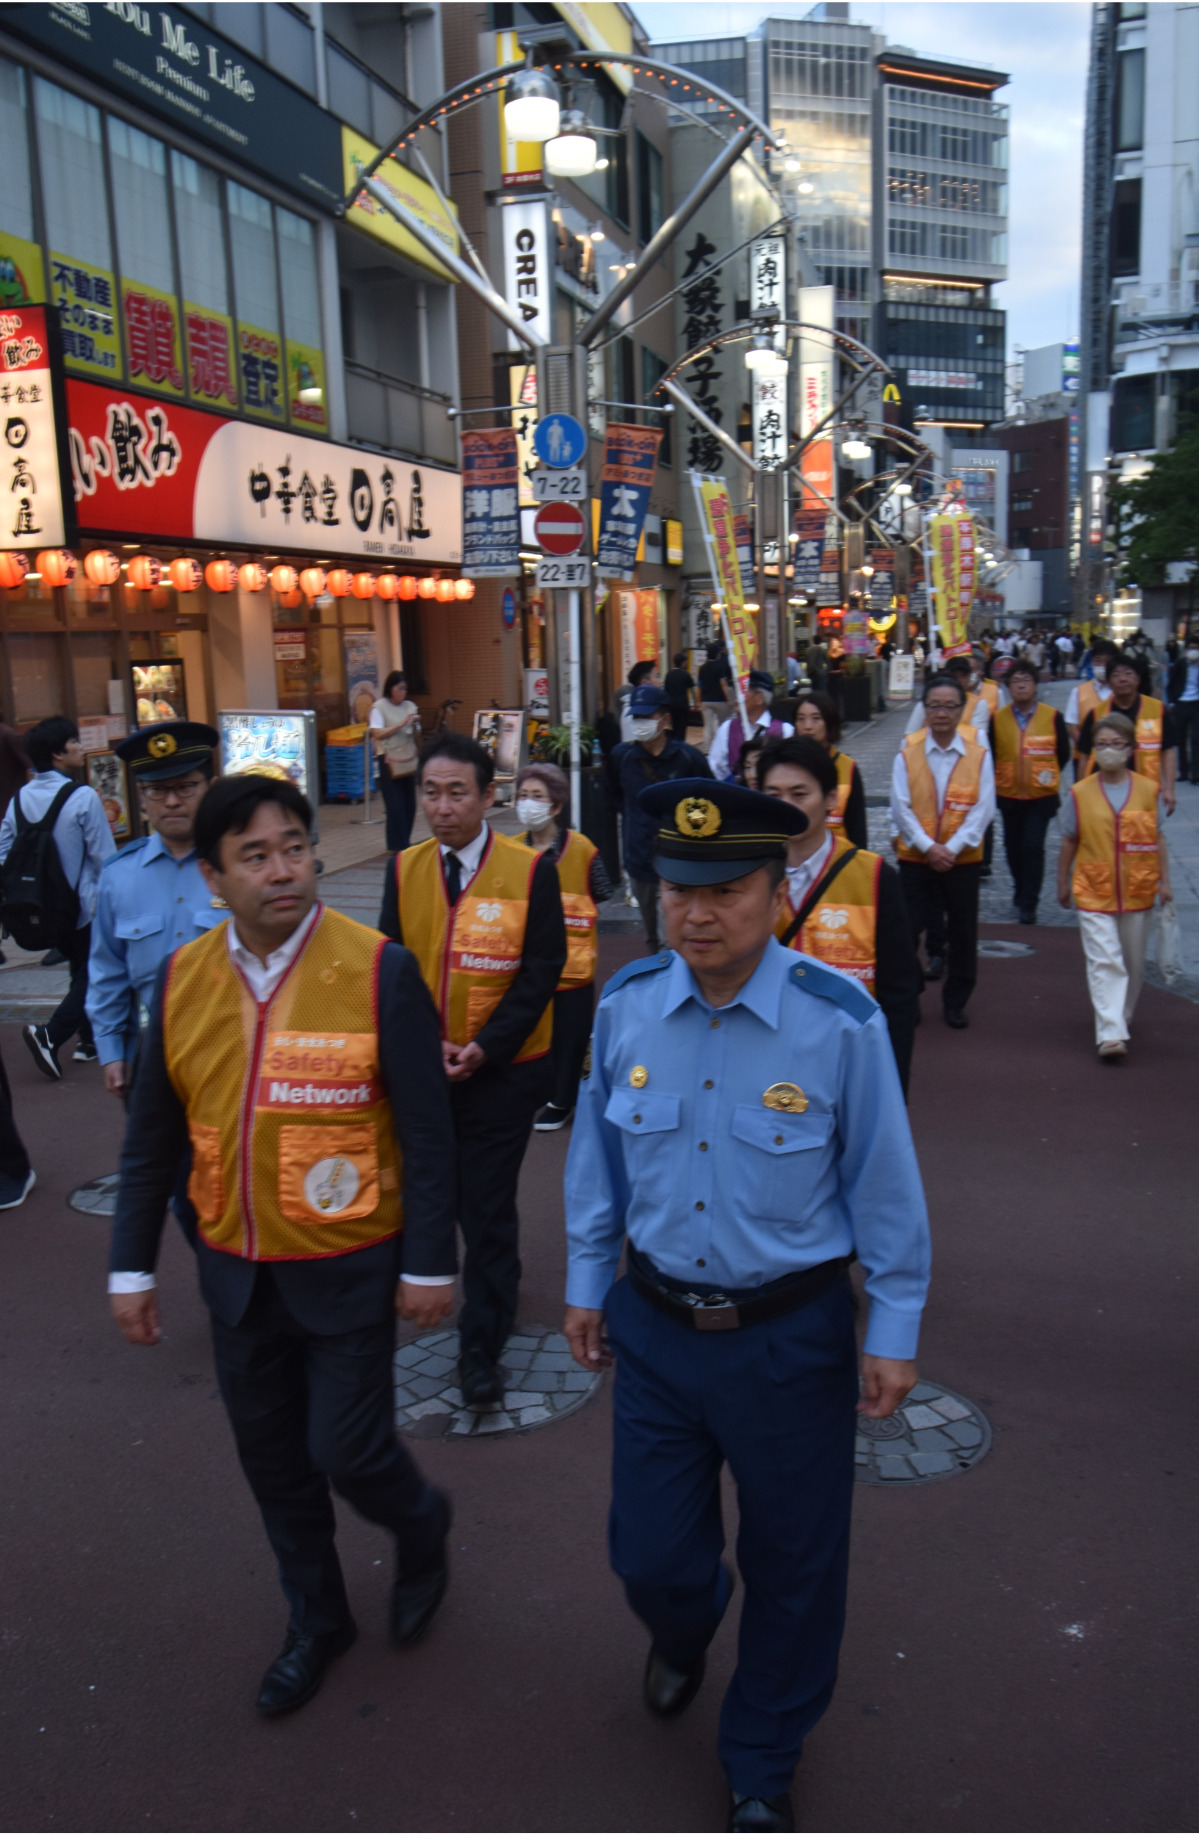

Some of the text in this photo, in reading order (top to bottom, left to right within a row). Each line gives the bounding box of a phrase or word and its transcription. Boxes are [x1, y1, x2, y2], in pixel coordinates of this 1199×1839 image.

[155, 55, 210, 101] Premium
[159, 12, 200, 66] Me
[206, 45, 255, 102] Life
[53, 261, 113, 309] 不動産
[516, 228, 538, 322] CREA
[4, 416, 43, 539] 日高屋
[249, 452, 431, 543] 中華食堂 日高屋
[537, 476, 582, 495] 7-22
[269, 1082, 371, 1105] Network
